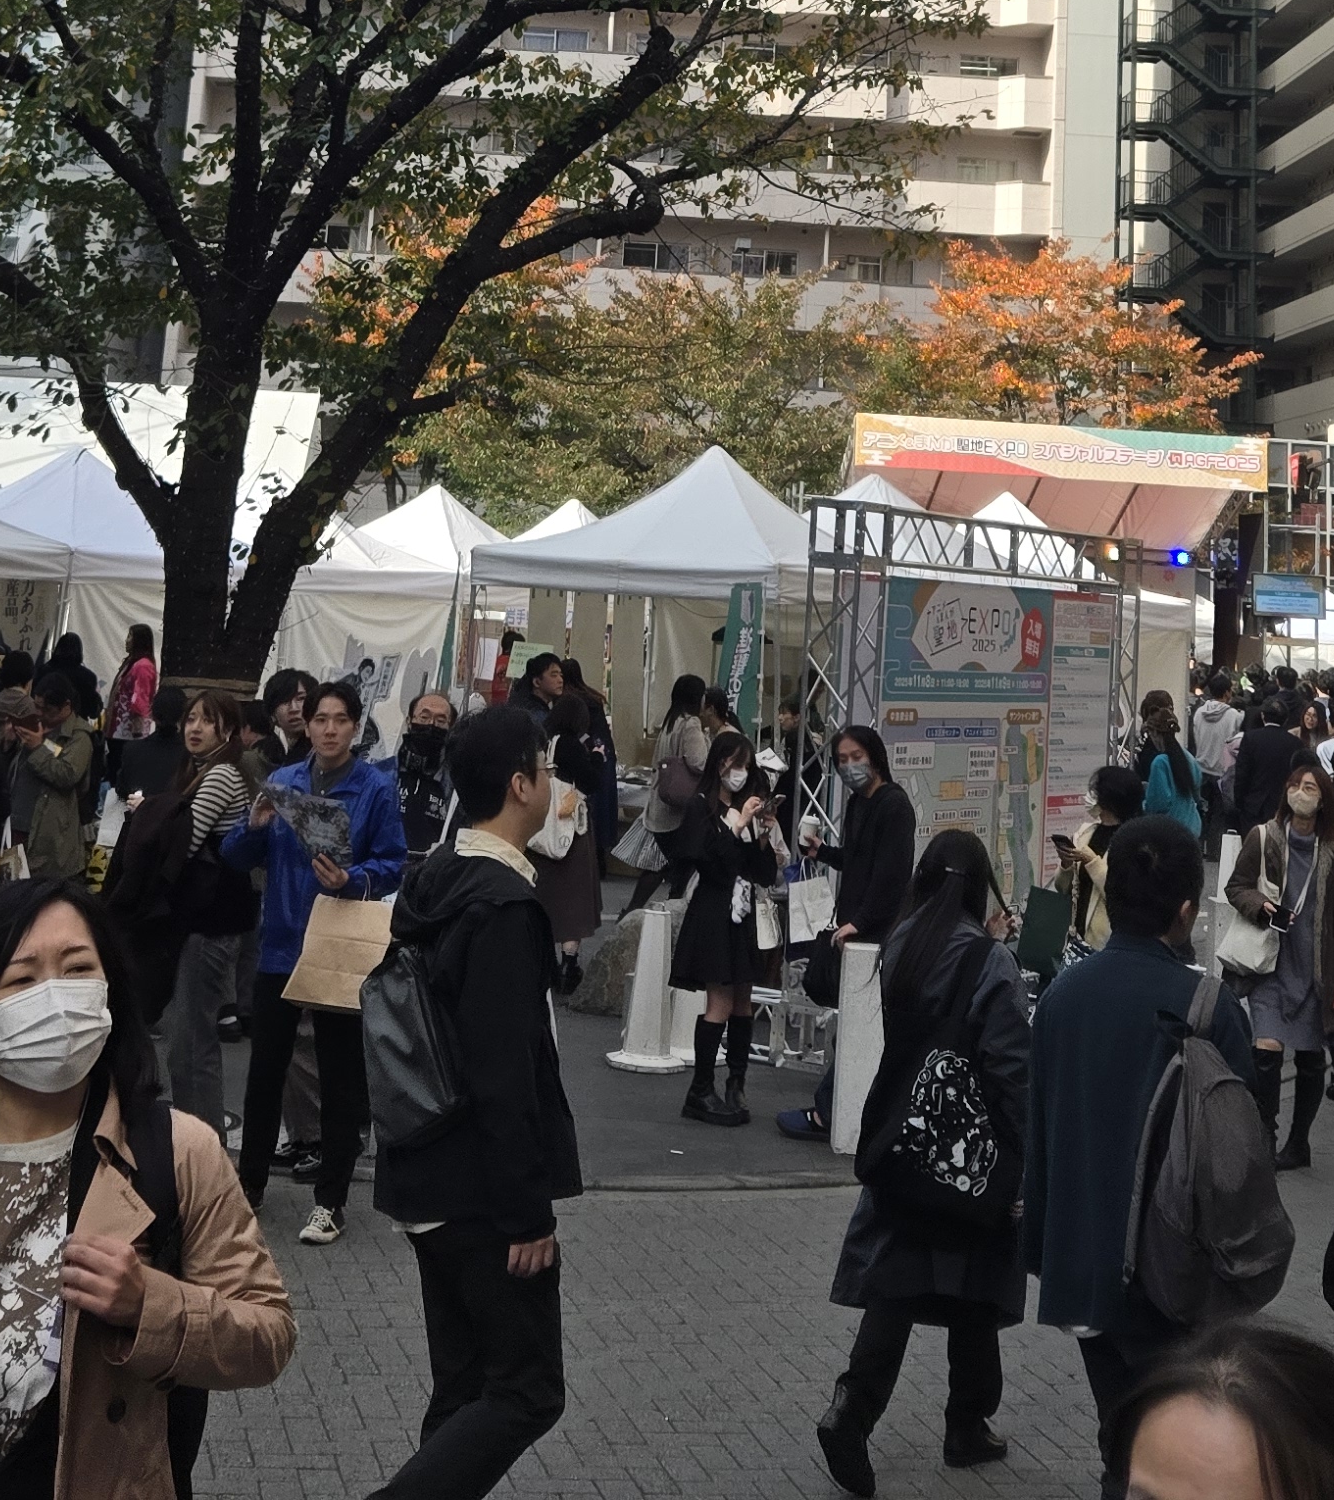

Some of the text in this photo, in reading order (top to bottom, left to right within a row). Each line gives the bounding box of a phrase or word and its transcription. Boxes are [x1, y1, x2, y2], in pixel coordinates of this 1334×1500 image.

[1033, 443, 1164, 467] スペシャルステージ
[1184, 453, 1261, 472] AGF2025
[968, 607, 1011, 636] EXPO
[1027, 619, 1043, 640] 入場
[972, 638, 996, 653] 2025
